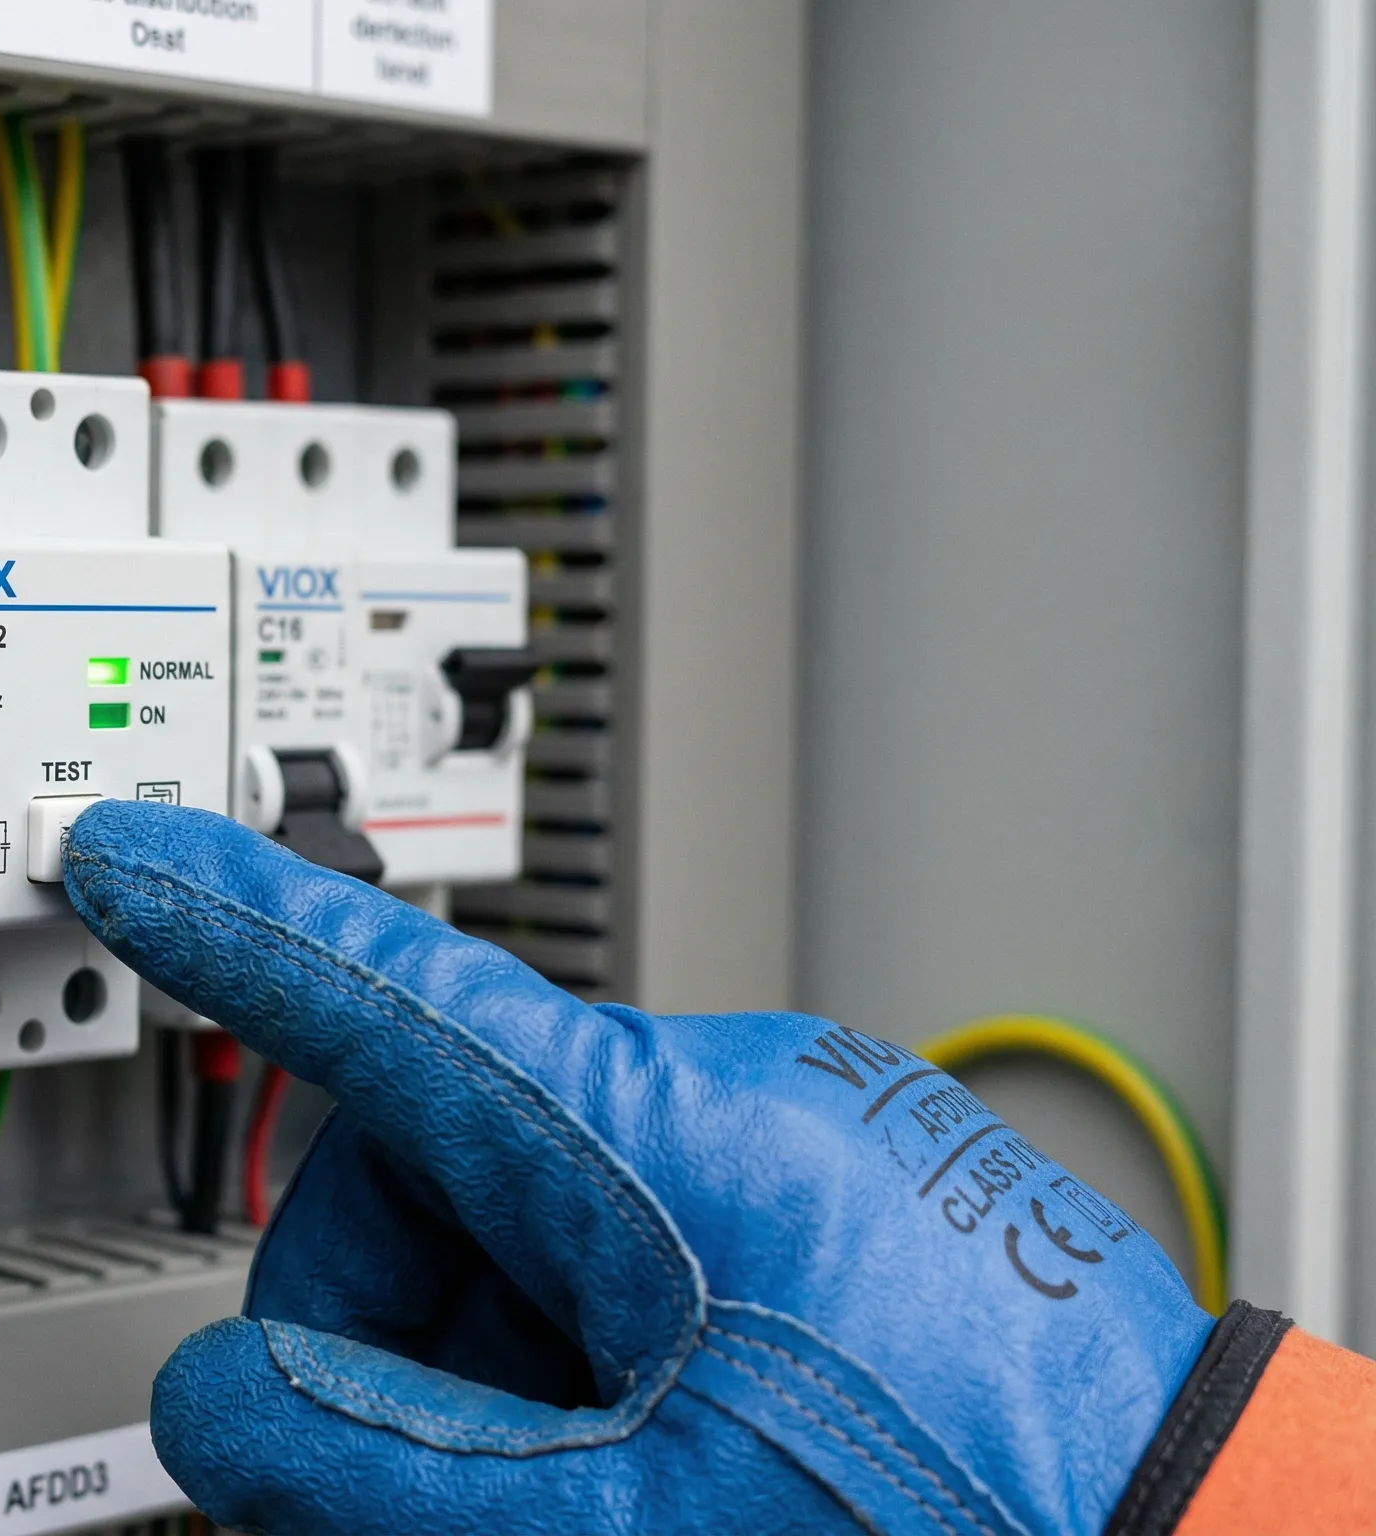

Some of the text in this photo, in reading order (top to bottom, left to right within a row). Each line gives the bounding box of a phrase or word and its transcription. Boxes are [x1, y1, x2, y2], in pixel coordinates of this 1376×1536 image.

[257, 566, 340, 598] VIOX
[258, 615, 303, 642] C16
[140, 661, 214, 680] NORMAL
[140, 705, 166, 725] ON
[41, 760, 93, 782] TEST
[941, 1149, 1022, 1235] CLASS
[3, 1460, 110, 1515] AFDD3
